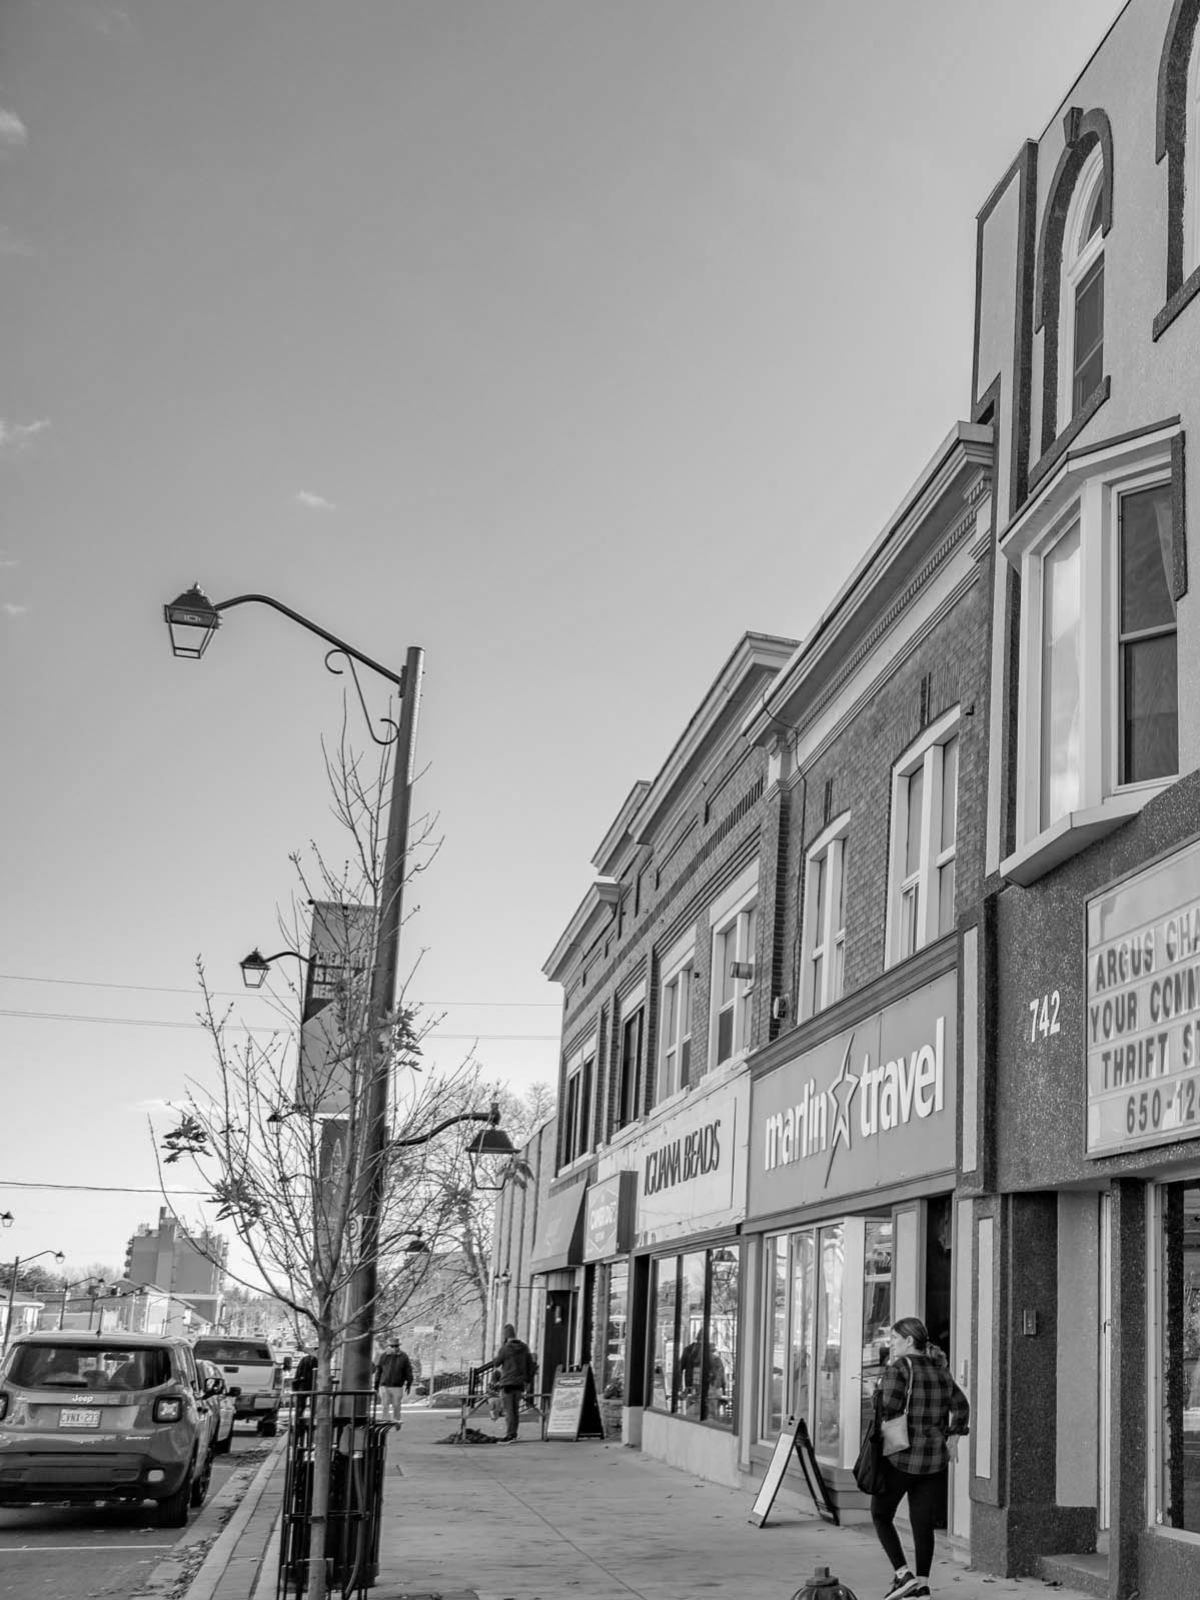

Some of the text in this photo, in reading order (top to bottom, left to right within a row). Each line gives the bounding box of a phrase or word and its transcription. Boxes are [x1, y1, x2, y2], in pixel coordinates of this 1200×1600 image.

[1096, 931, 1154, 992] ARGUS
[1029, 989, 1061, 1043] 742
[1090, 991, 1138, 1043] YOUR
[1101, 1032, 1169, 1089] THRIFT
[764, 1015, 946, 1171] marlin travel
[643, 1118, 722, 1197] IGUANA BEADS
[71, 1393, 94, 1404] Jeep
